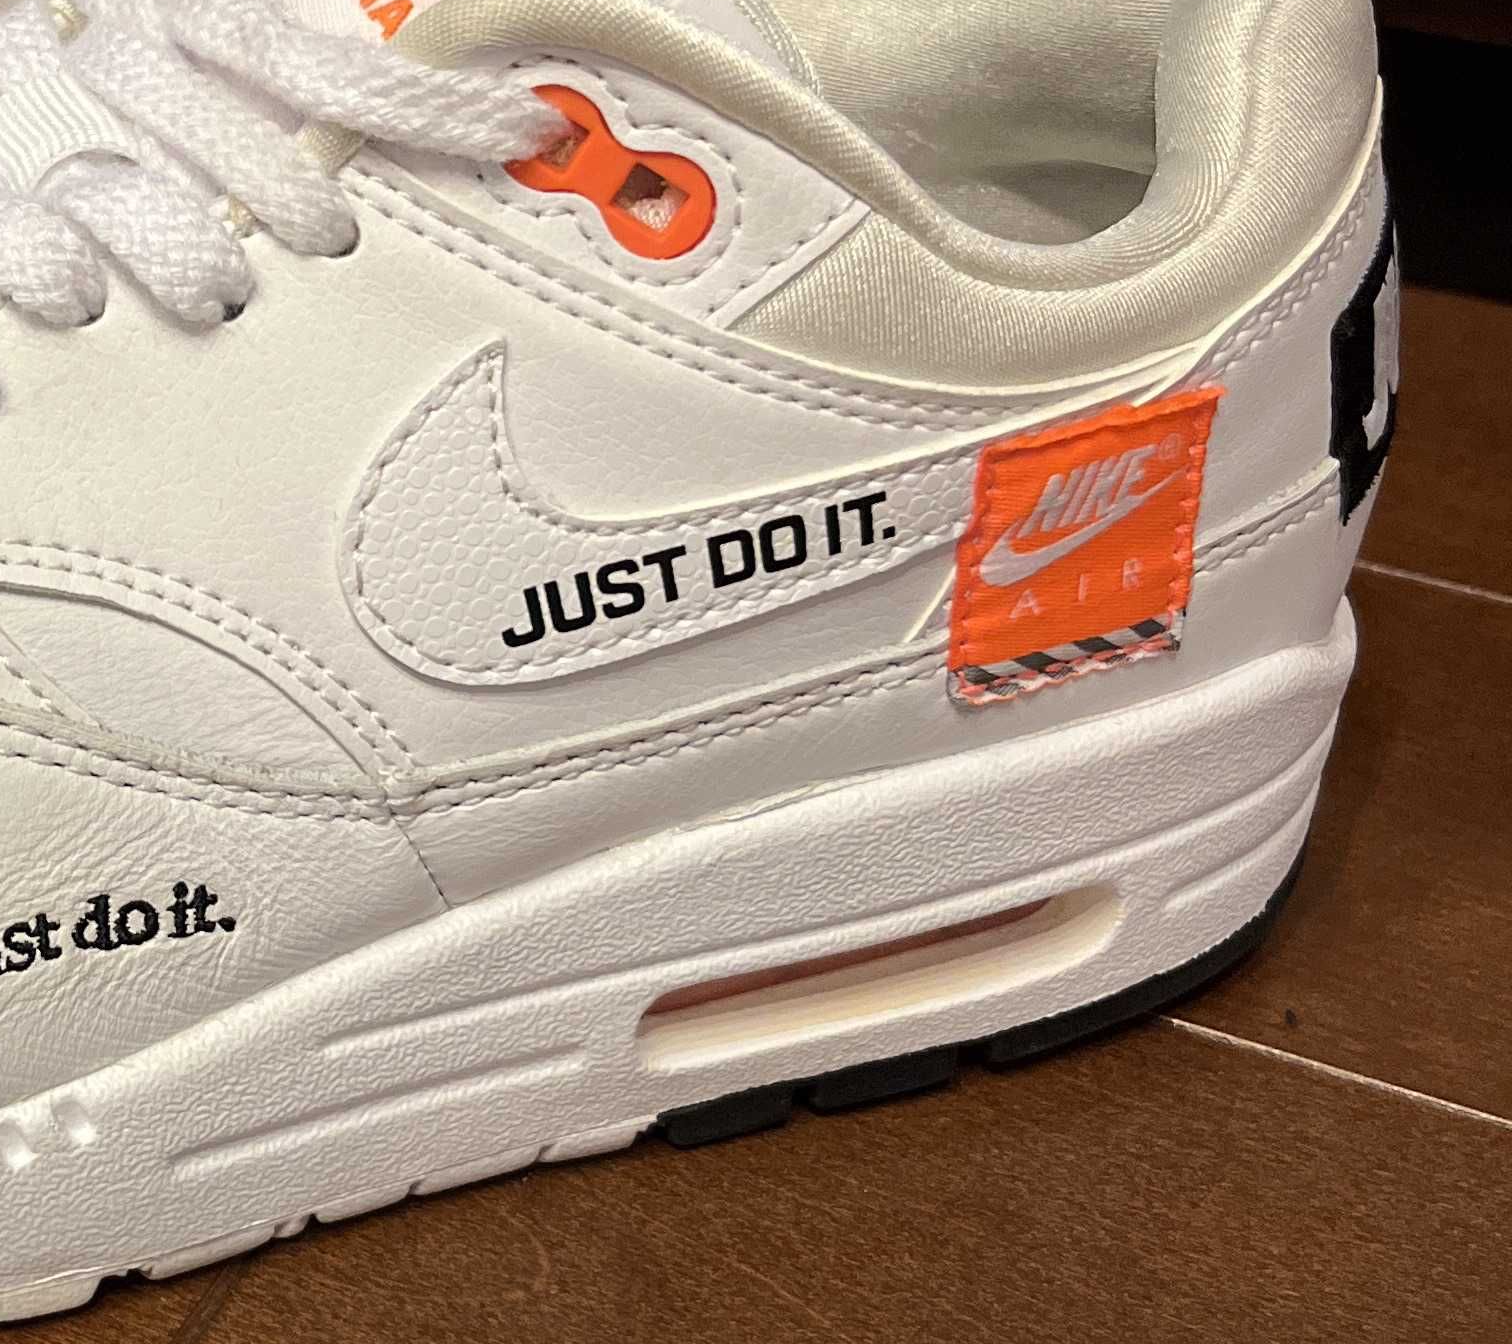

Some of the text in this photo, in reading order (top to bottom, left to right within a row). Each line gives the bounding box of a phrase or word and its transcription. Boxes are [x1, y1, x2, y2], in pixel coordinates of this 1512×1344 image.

[502, 491, 896, 648] JUST DO IT.
[71, 894, 160, 951] do
[166, 881, 236, 939] it.
